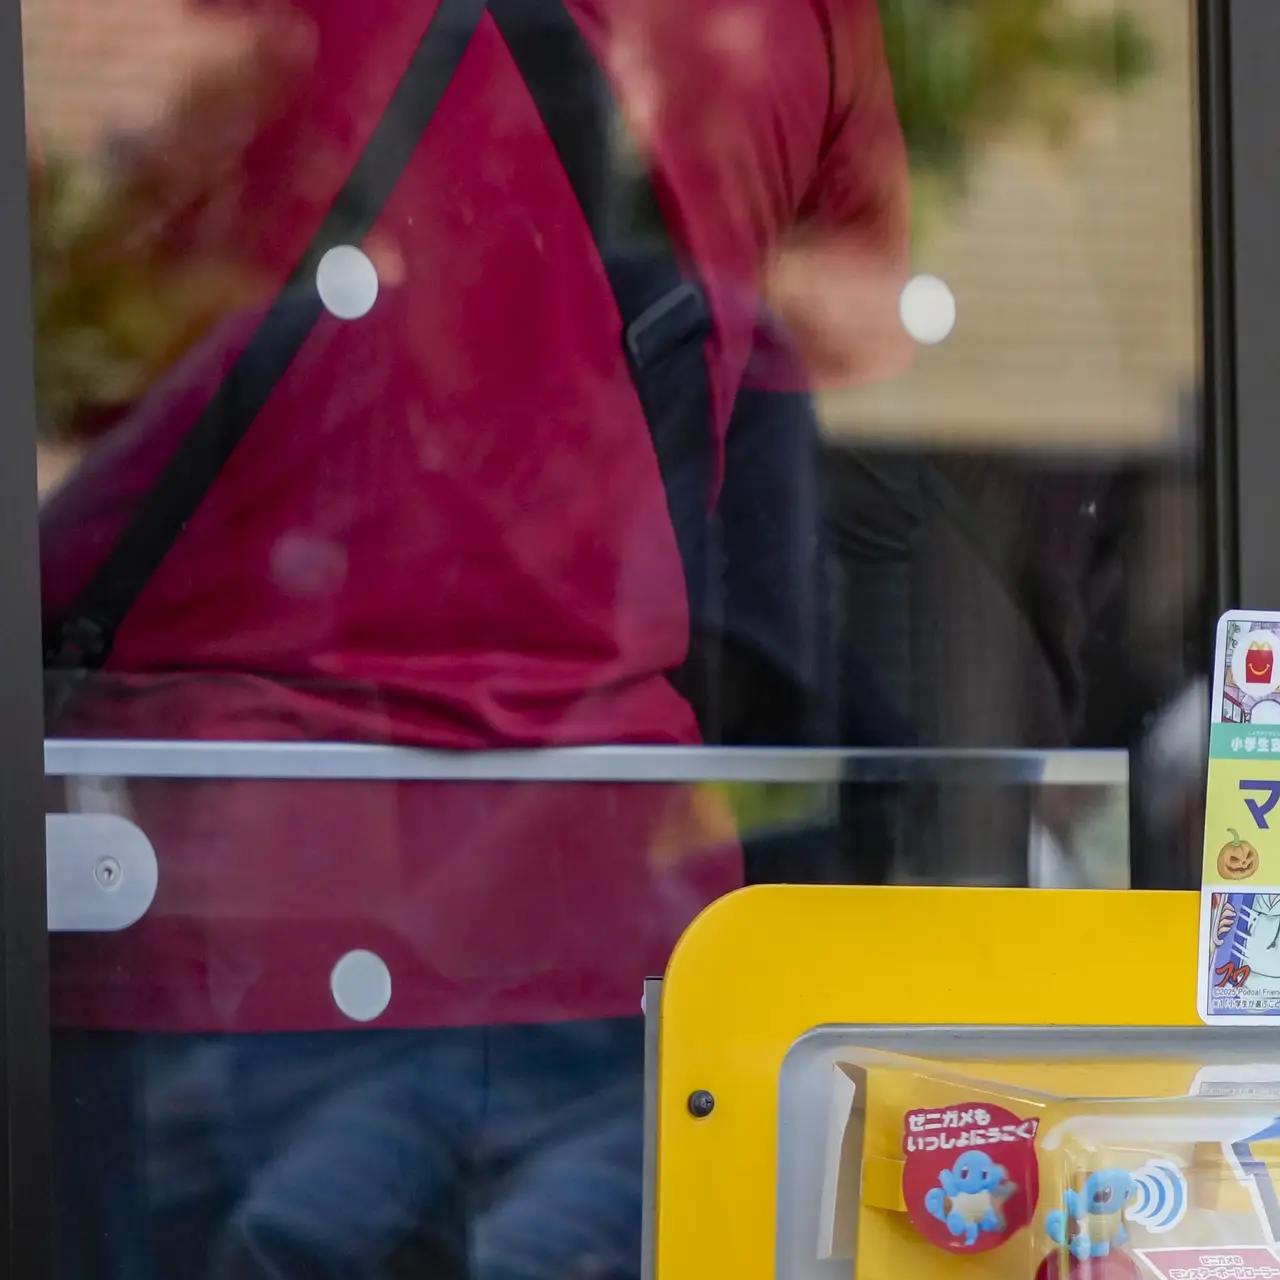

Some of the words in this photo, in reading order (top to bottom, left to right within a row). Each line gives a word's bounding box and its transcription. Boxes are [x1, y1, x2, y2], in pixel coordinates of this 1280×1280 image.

[909, 1109, 990, 1131] ゼニガメも
[907, 1120, 1038, 1151] いっしょにうごく!
[1200, 1256, 1243, 1266] ゼニガメの
[1170, 1268, 1280, 1280] モンスターボールローラー
